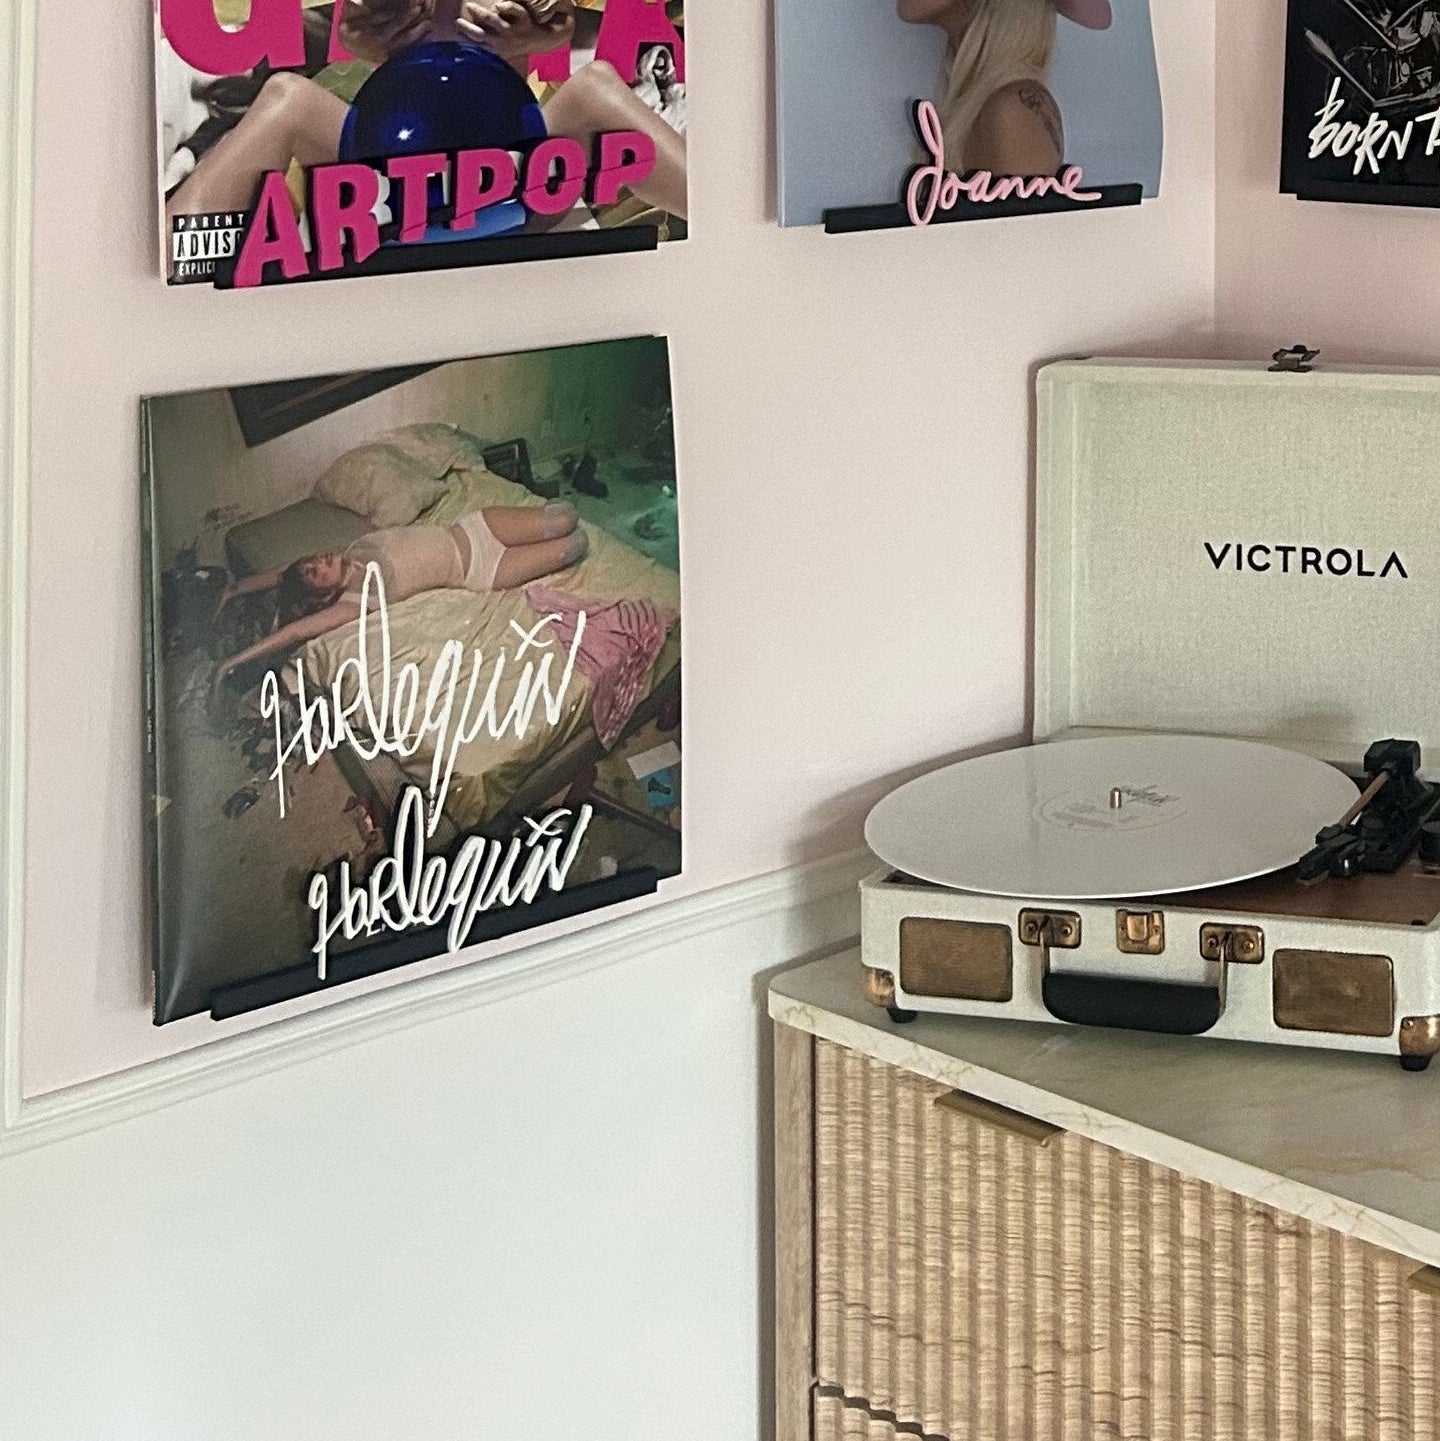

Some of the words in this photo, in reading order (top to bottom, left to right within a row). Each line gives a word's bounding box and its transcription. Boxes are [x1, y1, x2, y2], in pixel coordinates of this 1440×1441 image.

[907, 100, 1102, 225] Joanne
[178, 213, 244, 231] PARENT
[233, 131, 658, 288] ARTPOP
[1203, 542, 1408, 579] VICTROLA
